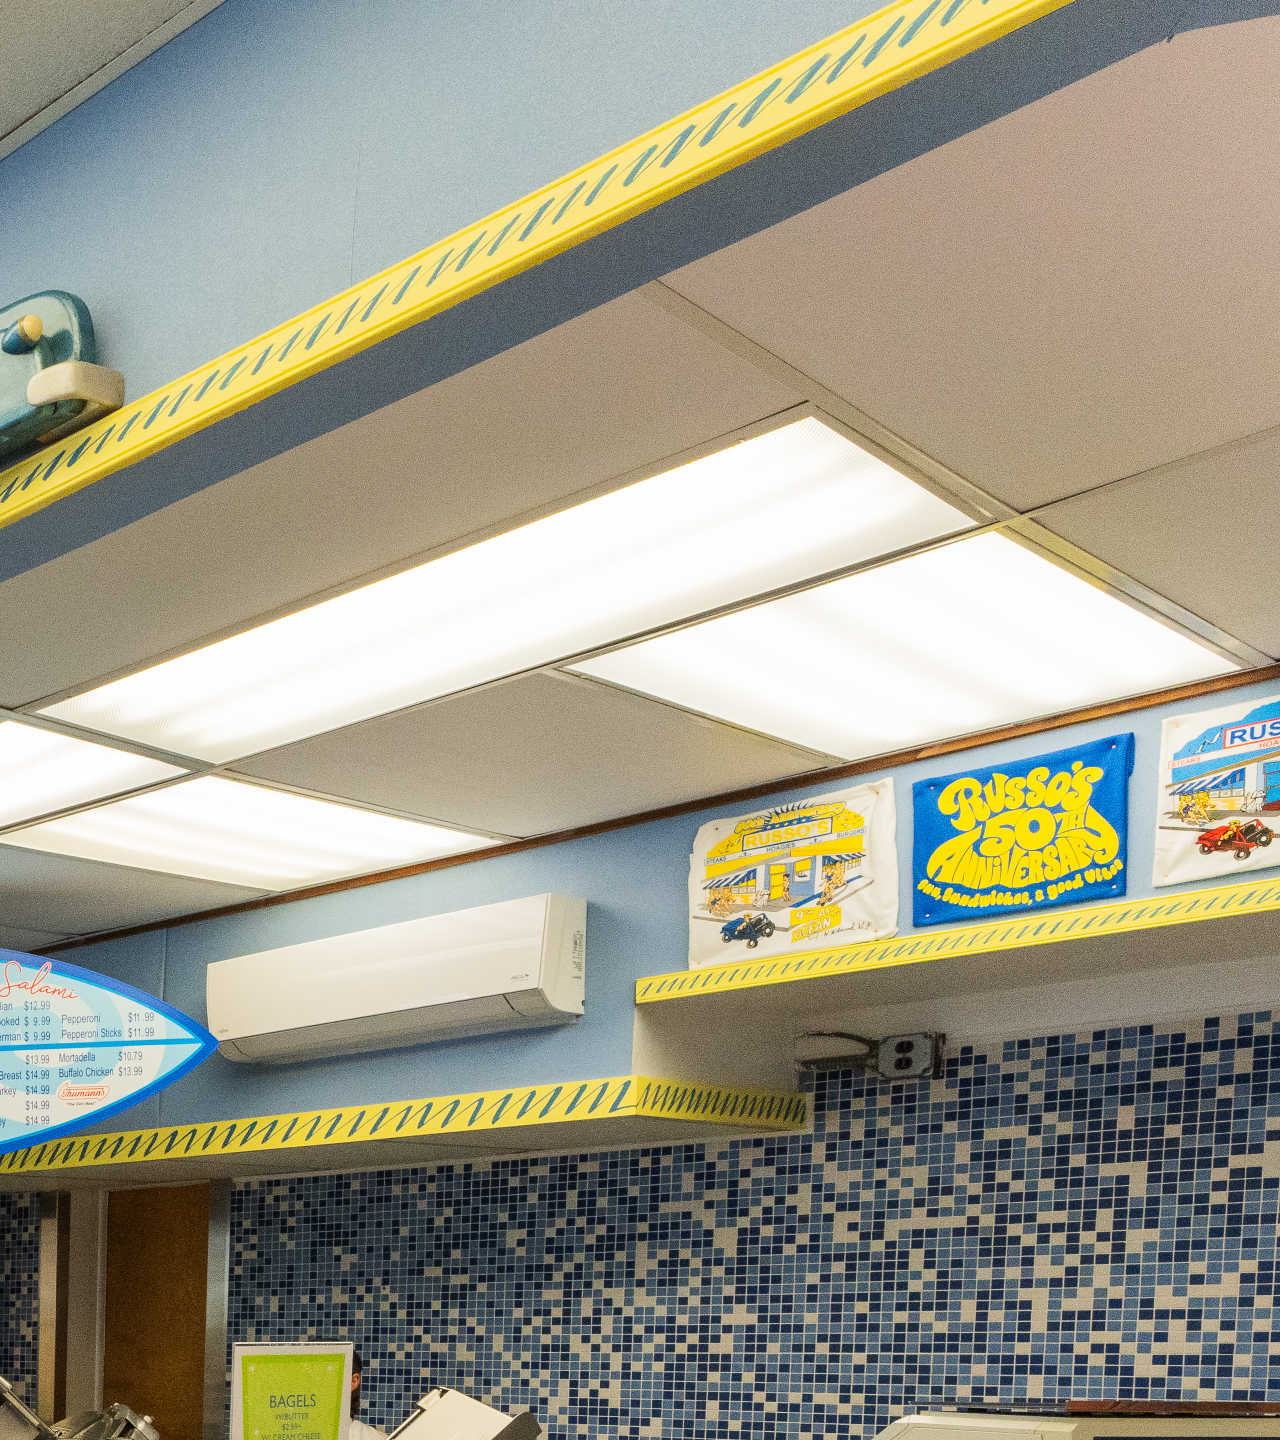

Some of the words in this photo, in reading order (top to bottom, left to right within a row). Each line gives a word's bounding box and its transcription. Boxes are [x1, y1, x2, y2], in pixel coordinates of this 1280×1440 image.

[937, 760, 1105, 832] RUSSO'S
[744, 819, 830, 850] RUSSO'S
[926, 802, 1120, 889] ANNIVERSARY
[979, 807, 1056, 857] 50
[61, 1014, 101, 1025] Pepperoni
[61, 1030, 99, 1040] Pepperoni
[100, 1028, 122, 1038] Sticks
[269, 1394, 317, 1409] BAGELS
